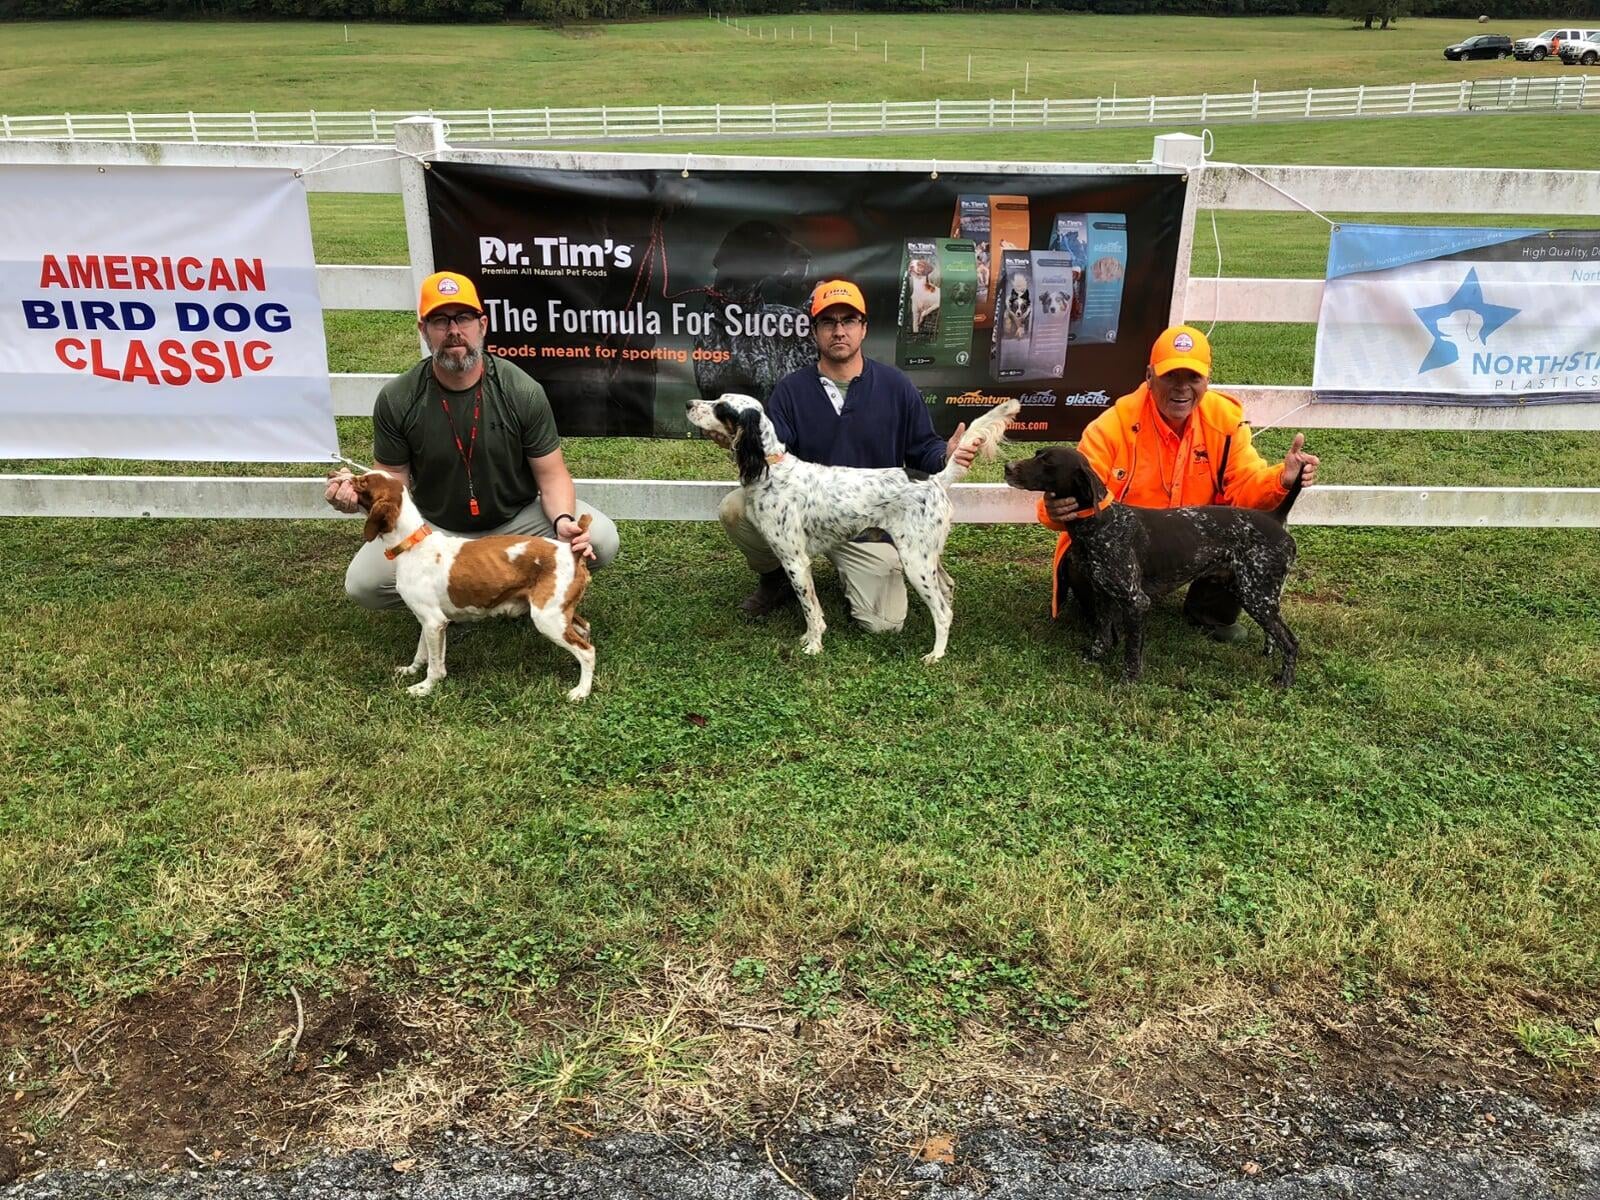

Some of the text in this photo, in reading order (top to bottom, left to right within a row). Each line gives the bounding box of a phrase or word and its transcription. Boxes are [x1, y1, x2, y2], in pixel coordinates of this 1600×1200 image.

[479, 236, 633, 269] Dr. Tim's
[1522, 247, 1546, 259] High
[1548, 246, 1588, 259] Quality,
[39, 254, 267, 292] AMERICAN
[481, 267, 519, 275] Premium
[520, 267, 532, 275] All
[534, 268, 564, 276] Natural
[582, 269, 608, 277] Foods
[1572, 269, 1600, 281] Nort
[21, 299, 292, 333] BIRD DOG
[483, 299, 811, 337] The Formula For Succe
[54, 337, 274, 386] CLASSIC
[487, 344, 730, 363] Foods meant for sporting dogs
[1495, 375, 1598, 391] PLASTICS
[945, 394, 1011, 404] momentum
[1020, 393, 1057, 404] fusion
[1064, 393, 1110, 406] glacier
